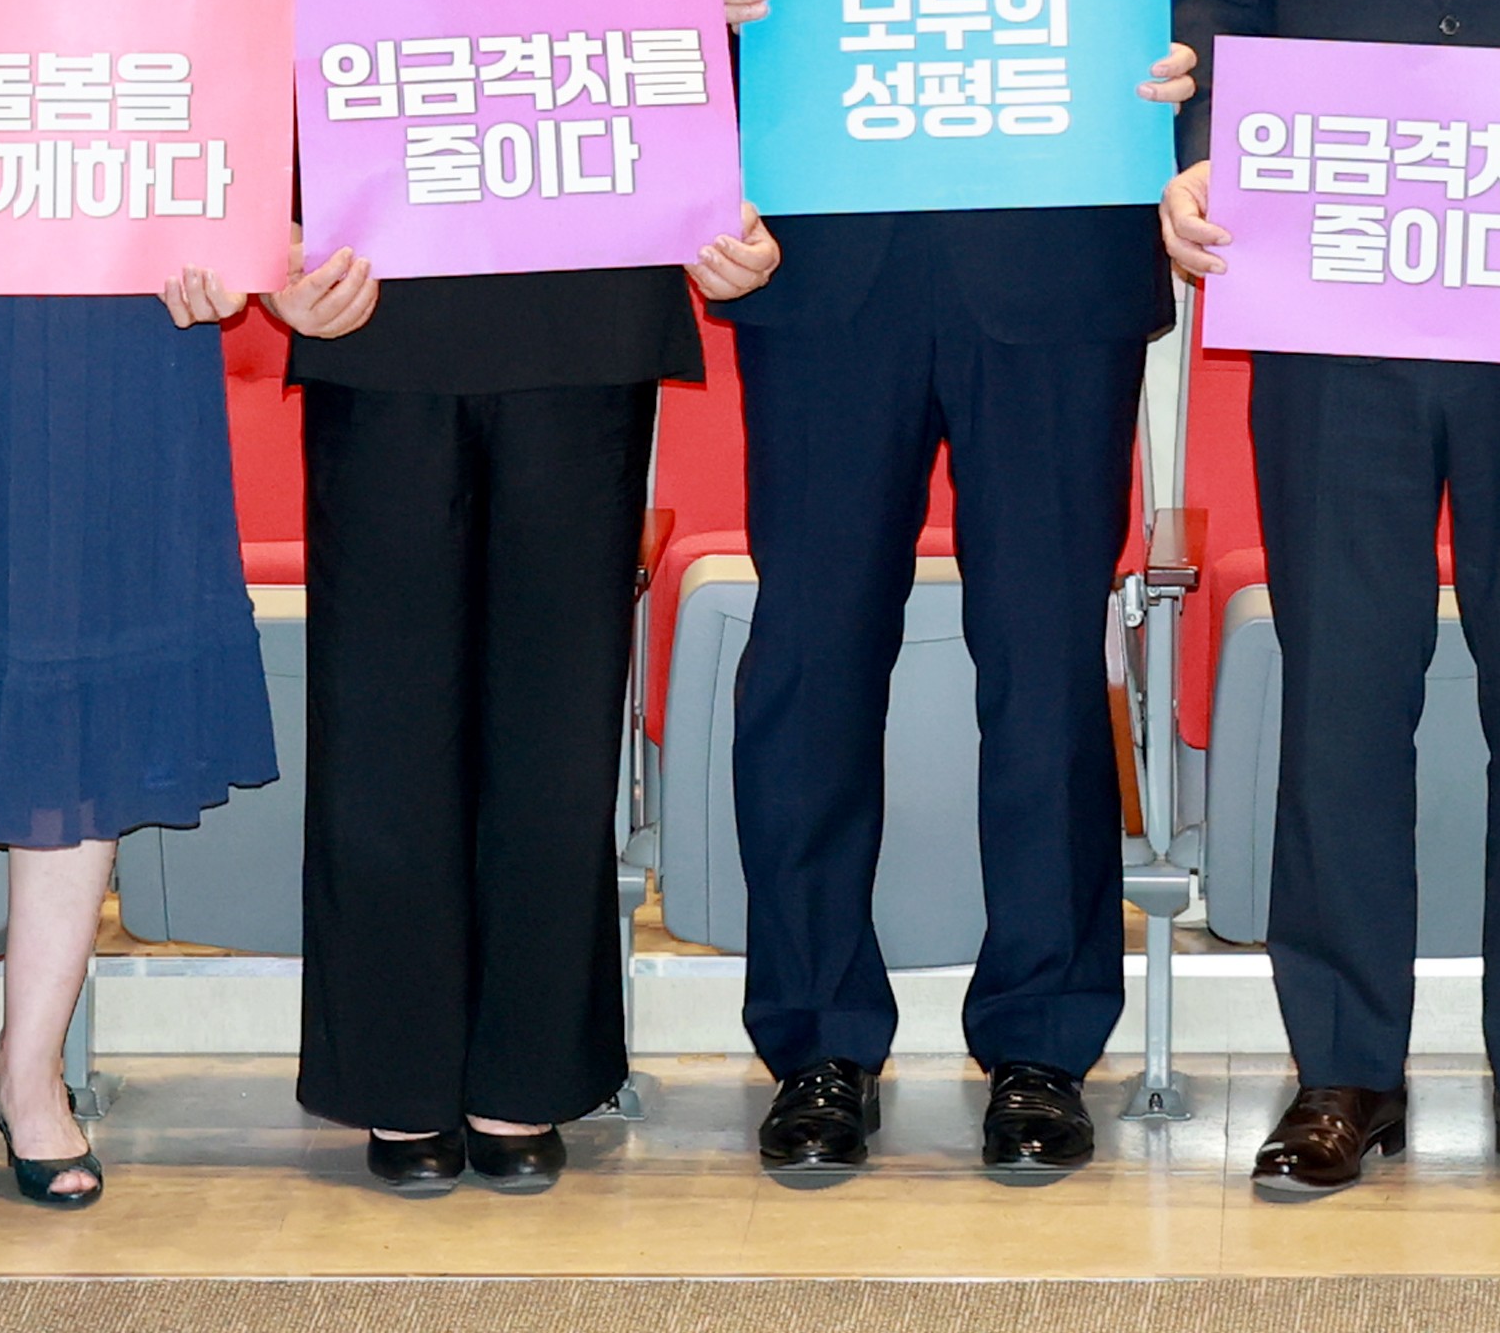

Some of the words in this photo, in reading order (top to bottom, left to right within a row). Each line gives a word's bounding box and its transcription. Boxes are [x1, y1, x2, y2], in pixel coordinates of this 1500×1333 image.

[323, 30, 706, 121] 임금격차를
[844, 58, 1071, 139] 성평등
[406, 117, 638, 203] 줄이다
